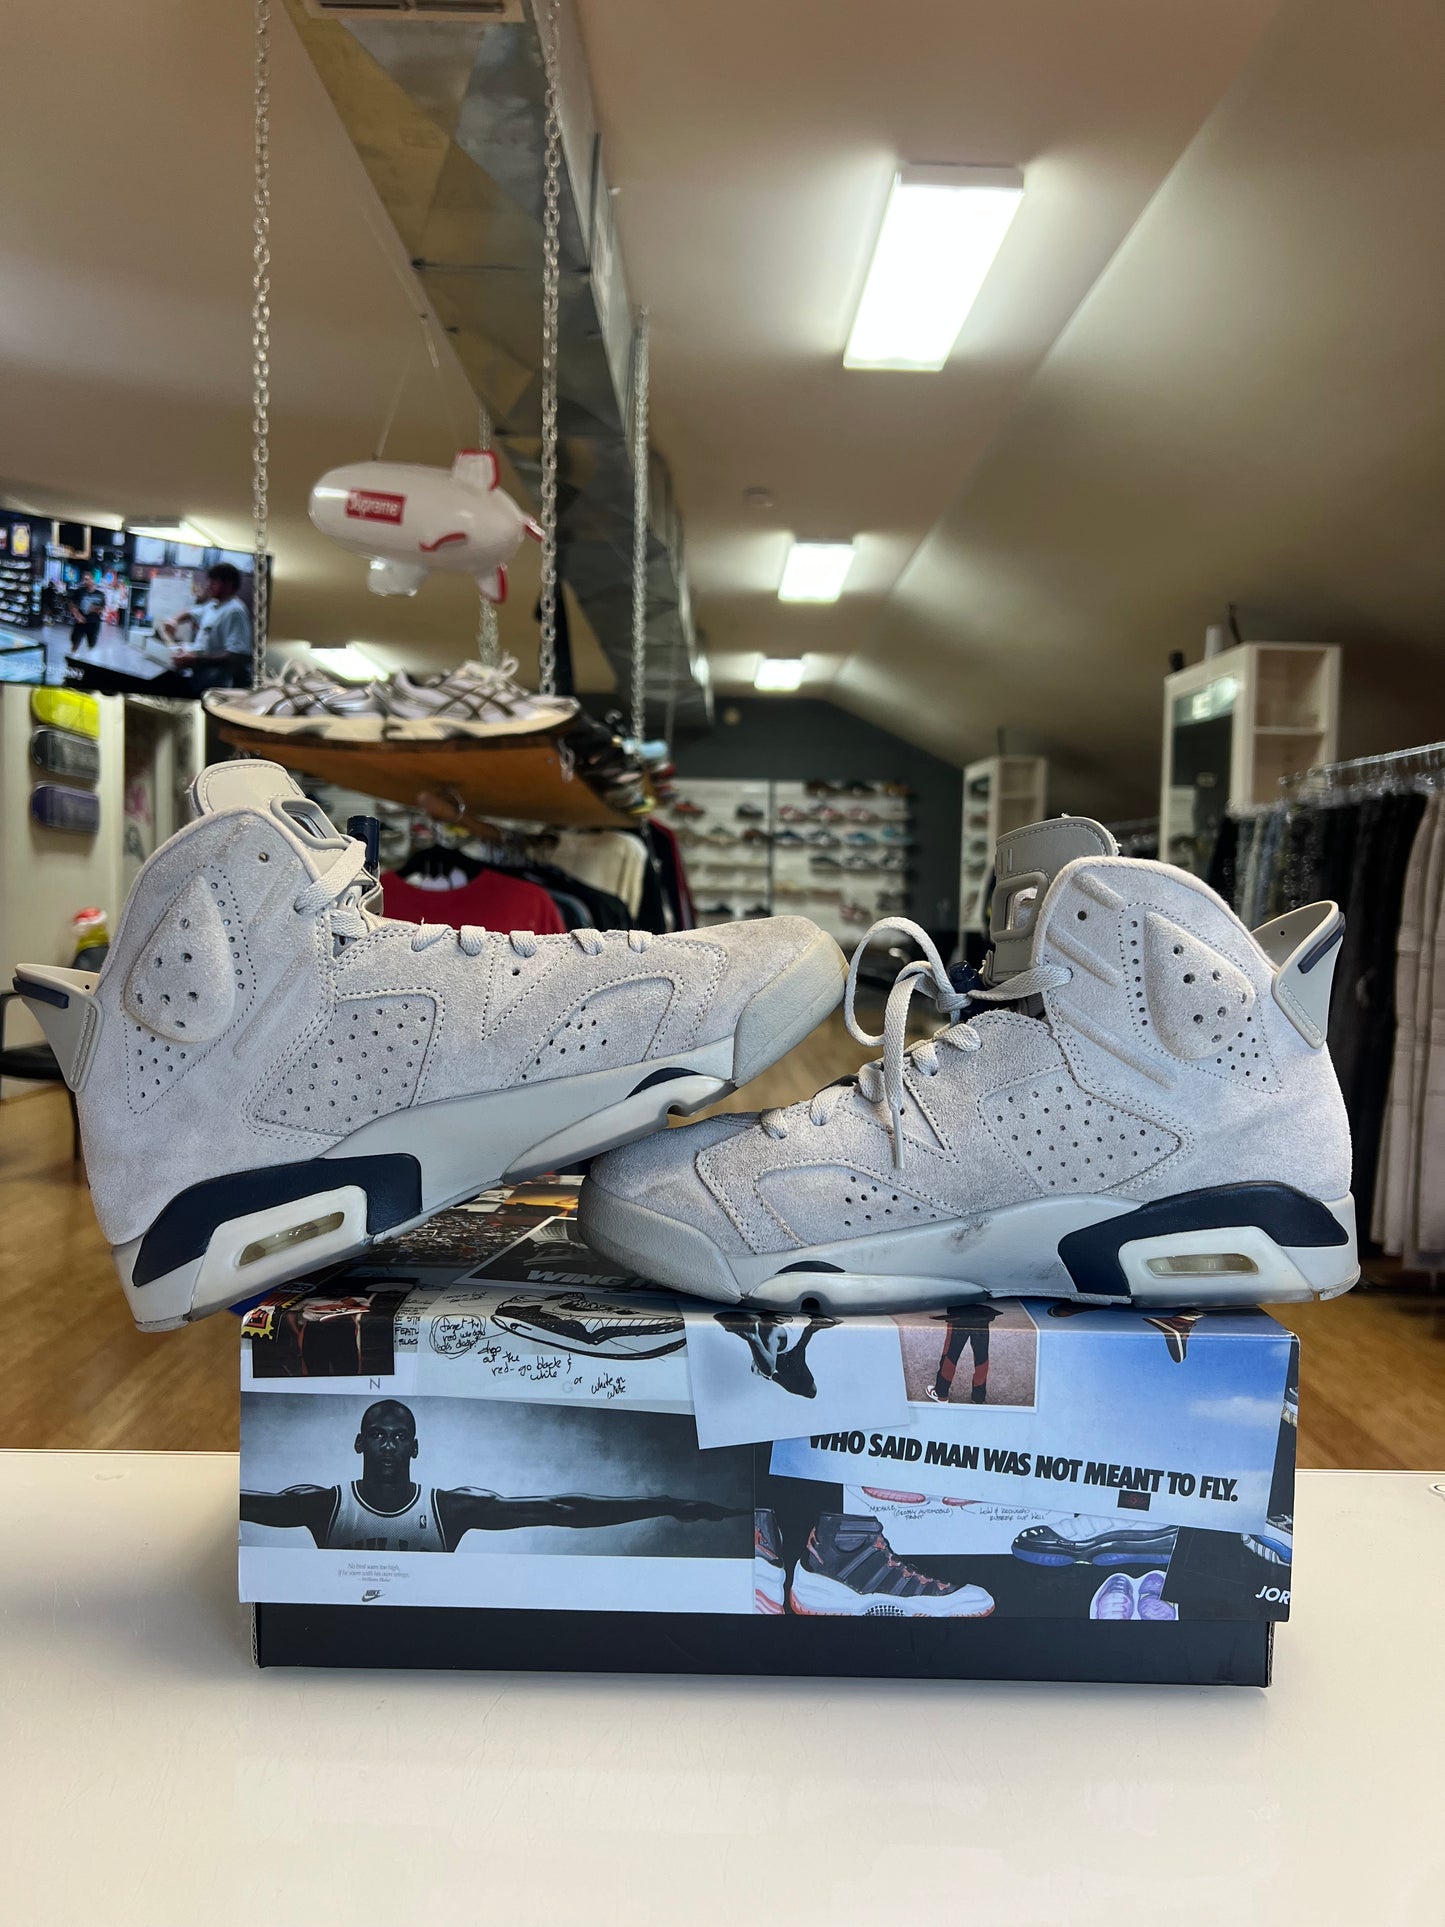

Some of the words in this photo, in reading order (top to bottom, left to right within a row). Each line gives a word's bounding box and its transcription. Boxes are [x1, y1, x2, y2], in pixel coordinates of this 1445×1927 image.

[527, 1270, 628, 1286] WING
[810, 1430, 867, 1455] WHO
[868, 1433, 923, 1462] SAID
[924, 1441, 980, 1469] MAN
[983, 1448, 1031, 1476] WAS
[1035, 1455, 1083, 1482] NOT
[1083, 1461, 1164, 1492] MEANT
[1167, 1471, 1196, 1497] TO
[1199, 1476, 1239, 1502] FLY.
